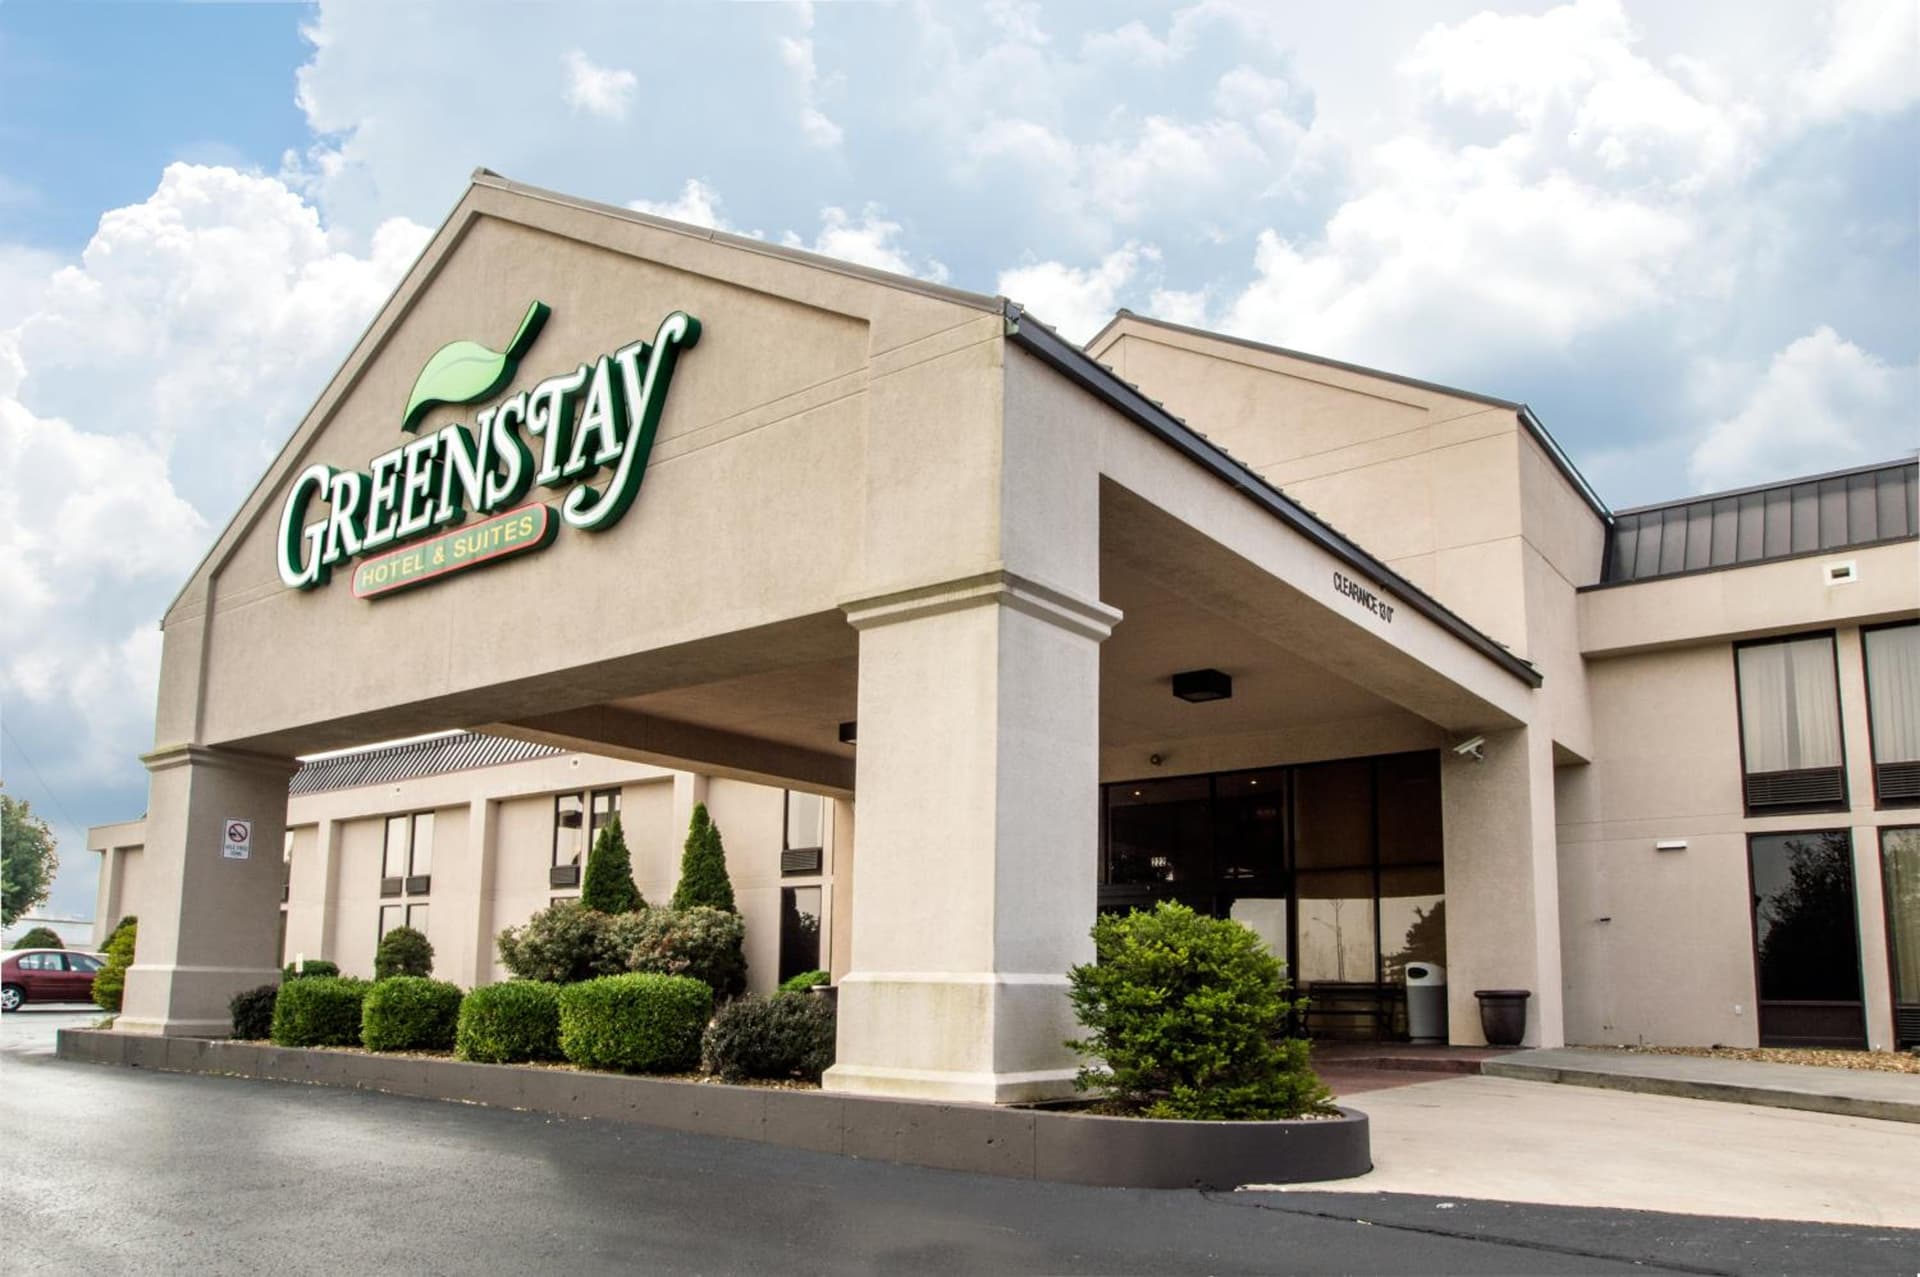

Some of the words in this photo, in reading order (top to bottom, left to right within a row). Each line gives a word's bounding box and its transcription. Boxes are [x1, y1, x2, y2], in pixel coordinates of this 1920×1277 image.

[277, 311, 701, 590] GREENSTAY
[362, 553, 425, 586] HOTEL
[432, 546, 446, 565] &
[453, 516, 534, 558] SUITES
[1333, 571, 1378, 615] CLEARANCE
